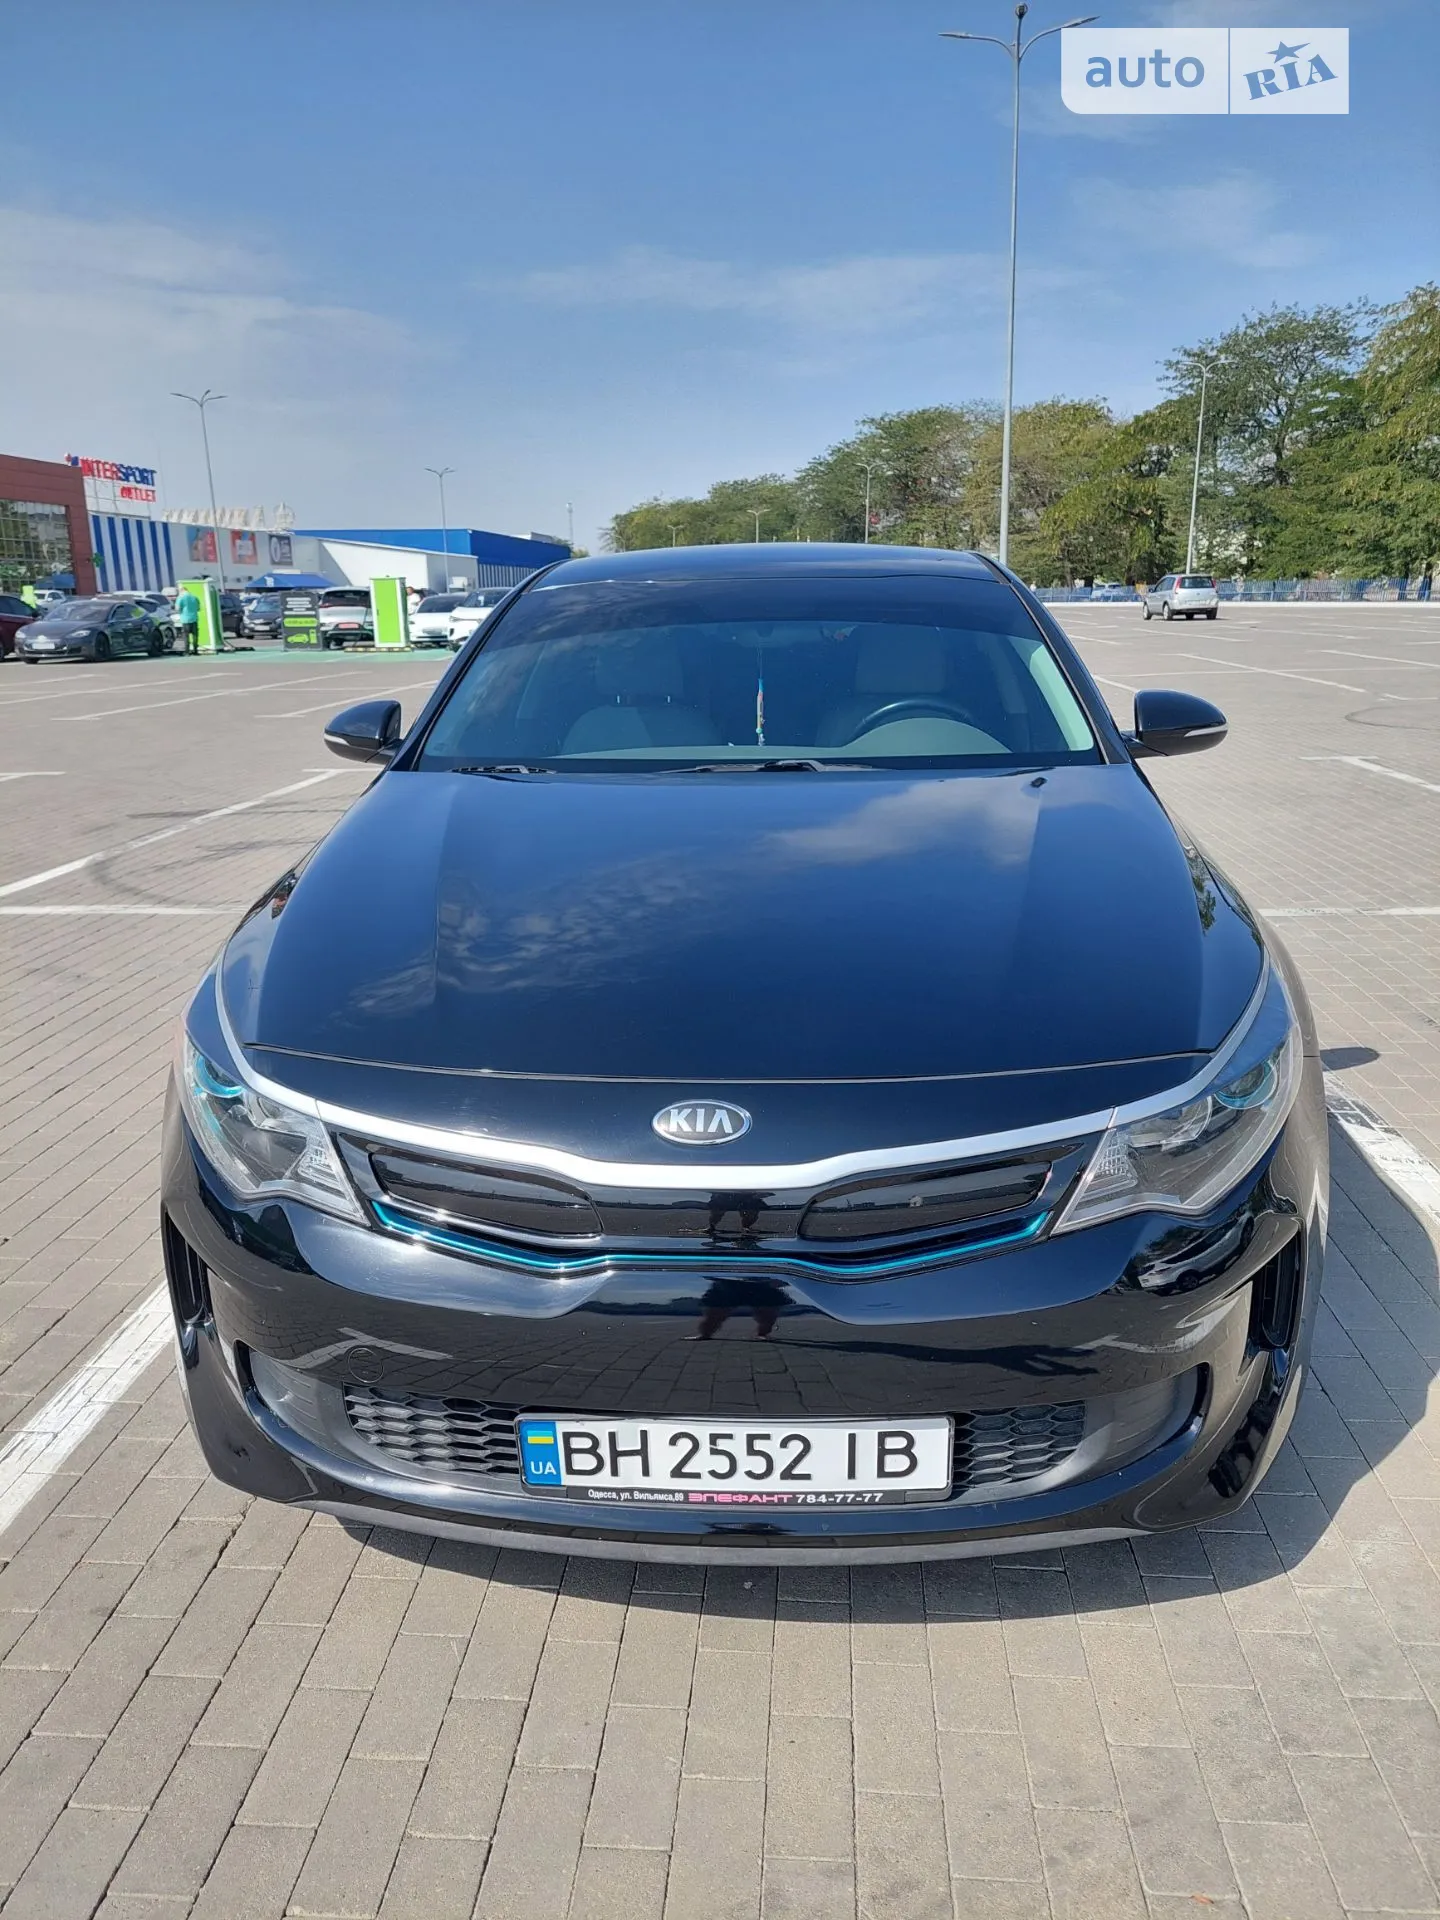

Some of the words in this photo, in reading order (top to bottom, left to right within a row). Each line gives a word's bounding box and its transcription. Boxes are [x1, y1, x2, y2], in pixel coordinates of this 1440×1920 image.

[80, 456, 157, 487] INTERSPORT
[669, 1108, 733, 1133] KIA
[562, 1429, 650, 1477] BH
[669, 1431, 812, 1481] 2552
[847, 1430, 918, 1480] IB
[530, 1461, 557, 1475] UA
[588, 1489, 619, 1500] Одесса,
[620, 1491, 631, 1501] ул.
[796, 1493, 884, 1504] 784-77-77
